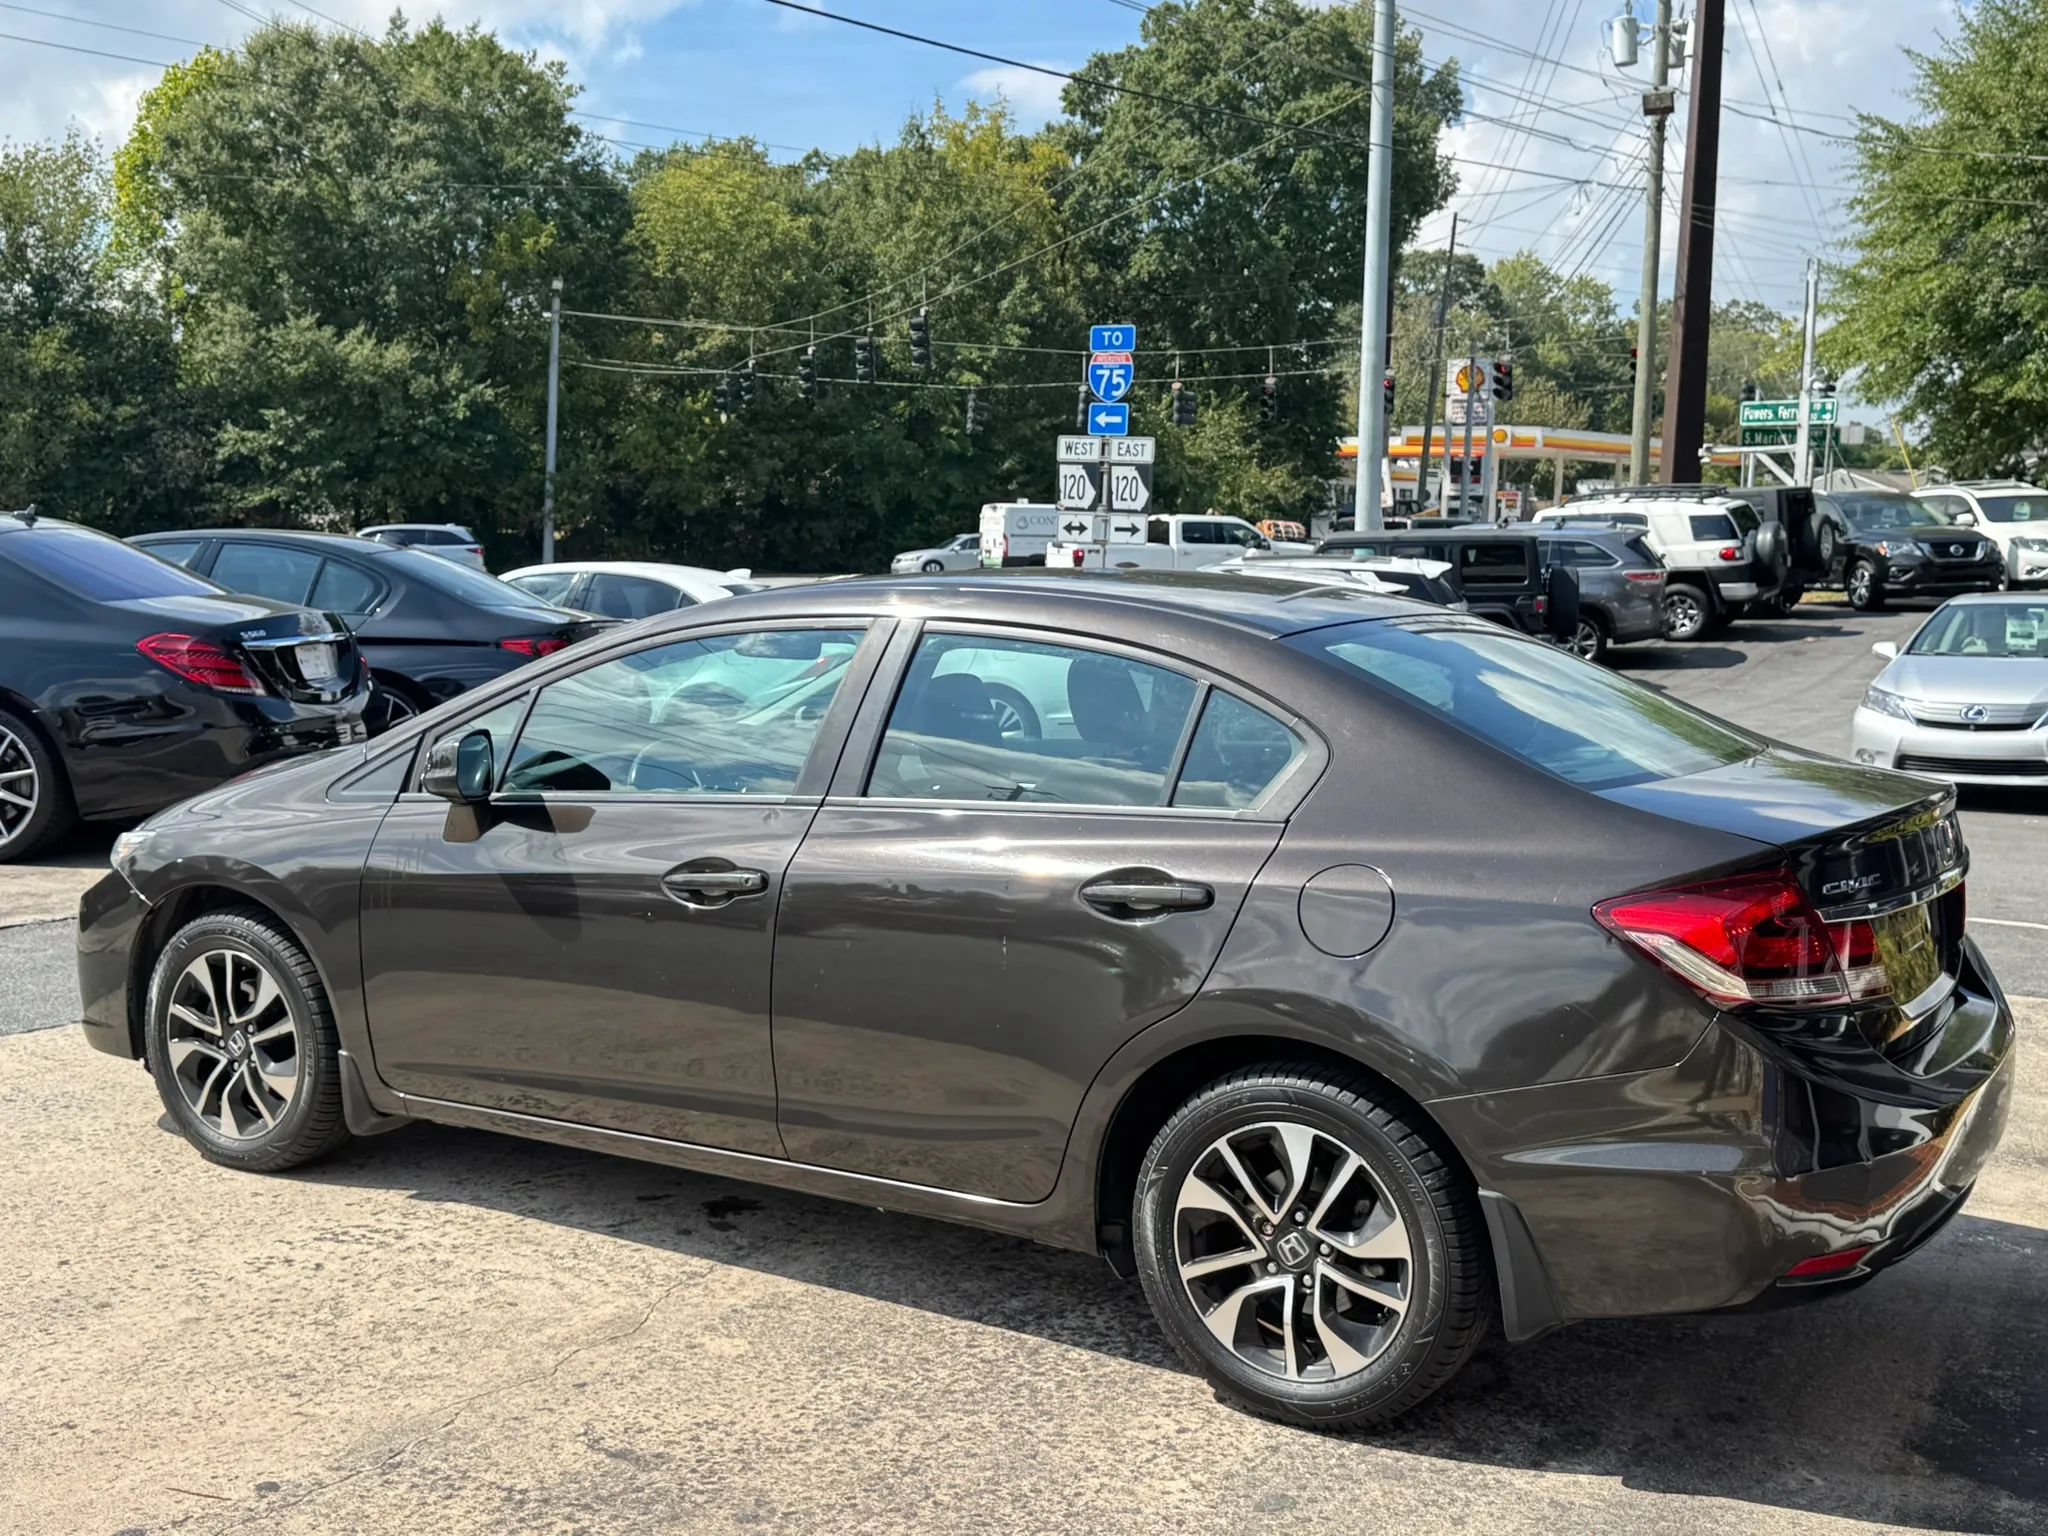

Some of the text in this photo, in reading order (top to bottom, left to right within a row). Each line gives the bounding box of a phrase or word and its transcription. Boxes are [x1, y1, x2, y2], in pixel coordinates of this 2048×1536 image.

[1102, 331, 1123, 346] TO
[1095, 369, 1126, 397] 75
[1743, 406, 1774, 420] Powers
[1064, 440, 1094, 456] WEST
[1117, 441, 1146, 457] EAST
[1063, 473, 1086, 500] 120
[1115, 475, 1139, 502] 120
[1029, 515, 1057, 526] CON
[1822, 873, 1881, 895] CIVIC
